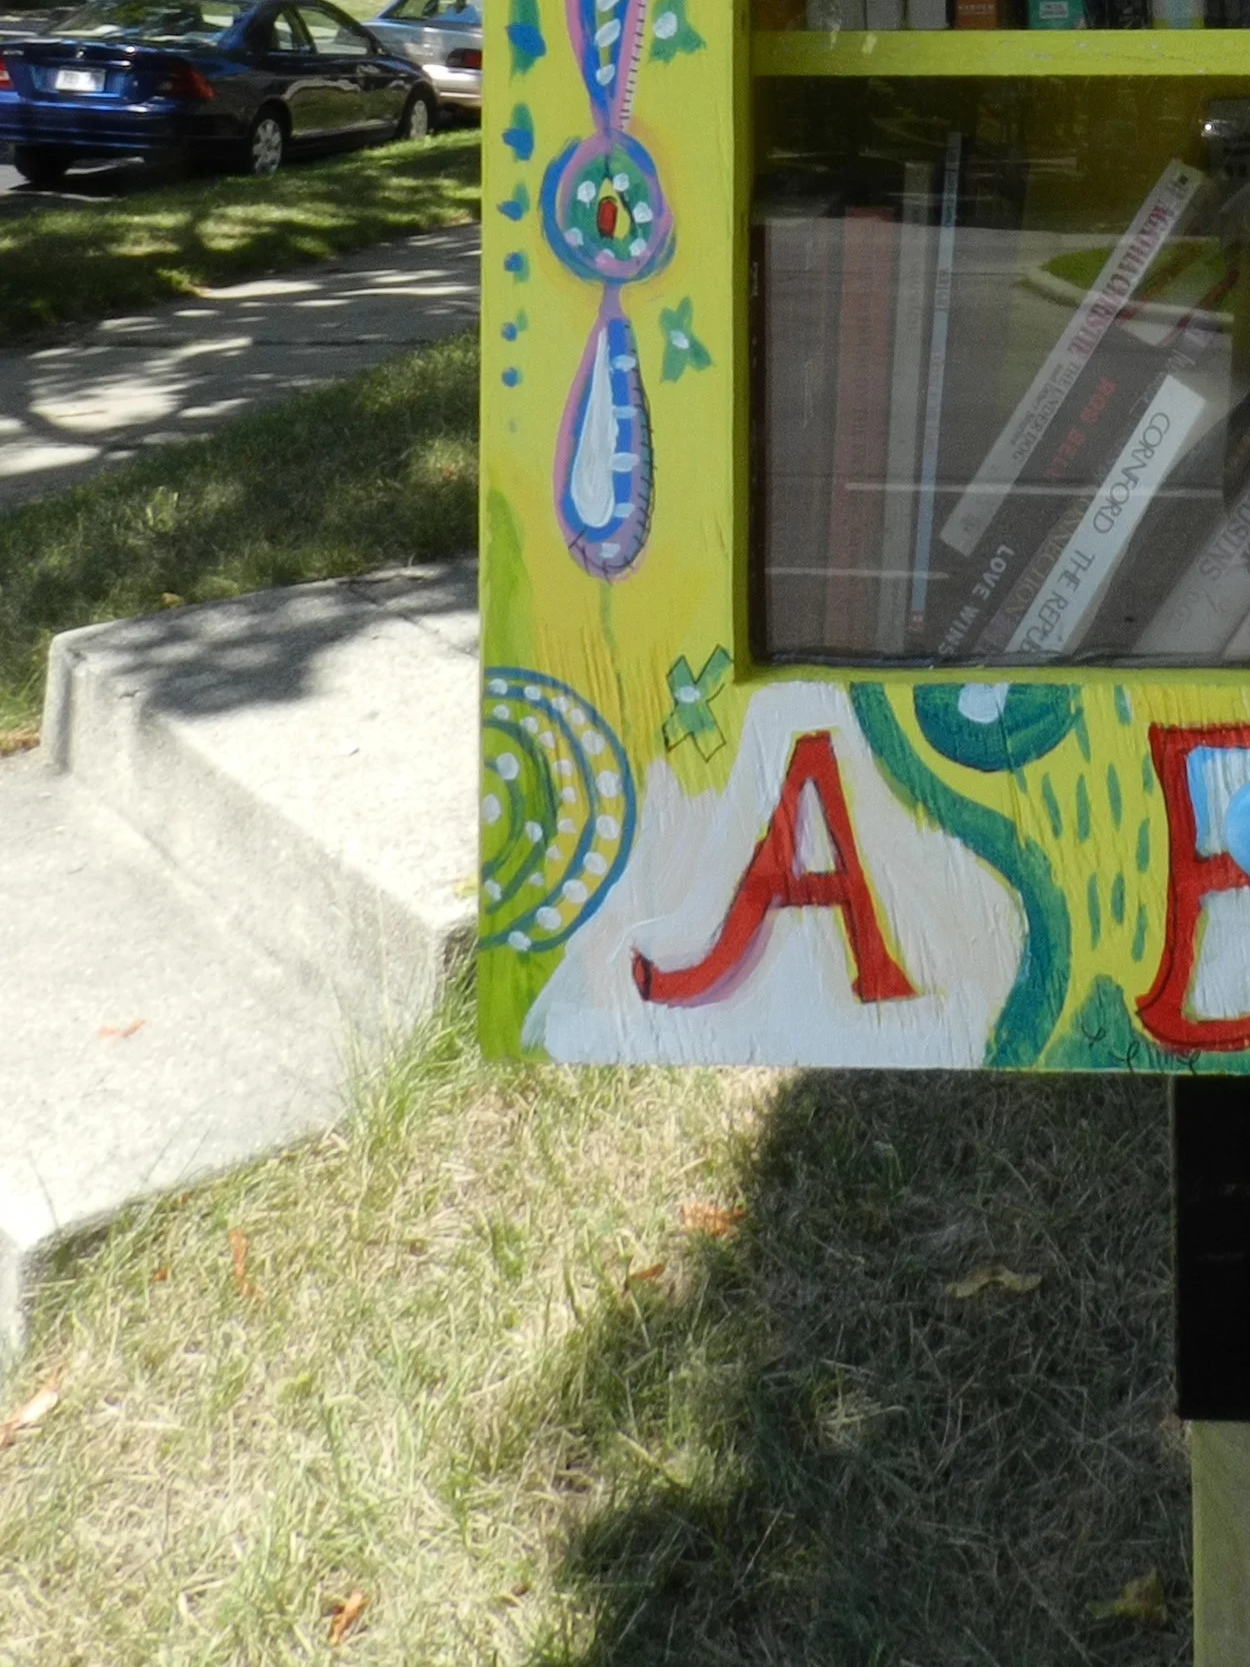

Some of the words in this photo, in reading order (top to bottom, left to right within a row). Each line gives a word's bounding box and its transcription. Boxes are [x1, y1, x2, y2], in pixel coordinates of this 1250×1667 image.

[1009, 428, 1039, 465] DOG
[1081, 406, 1180, 540] CORNFORD
[969, 541, 1018, 603] LOVE
[1053, 543, 1098, 595] THE
[933, 601, 983, 662] WINS
[632, 732, 917, 1007] A
